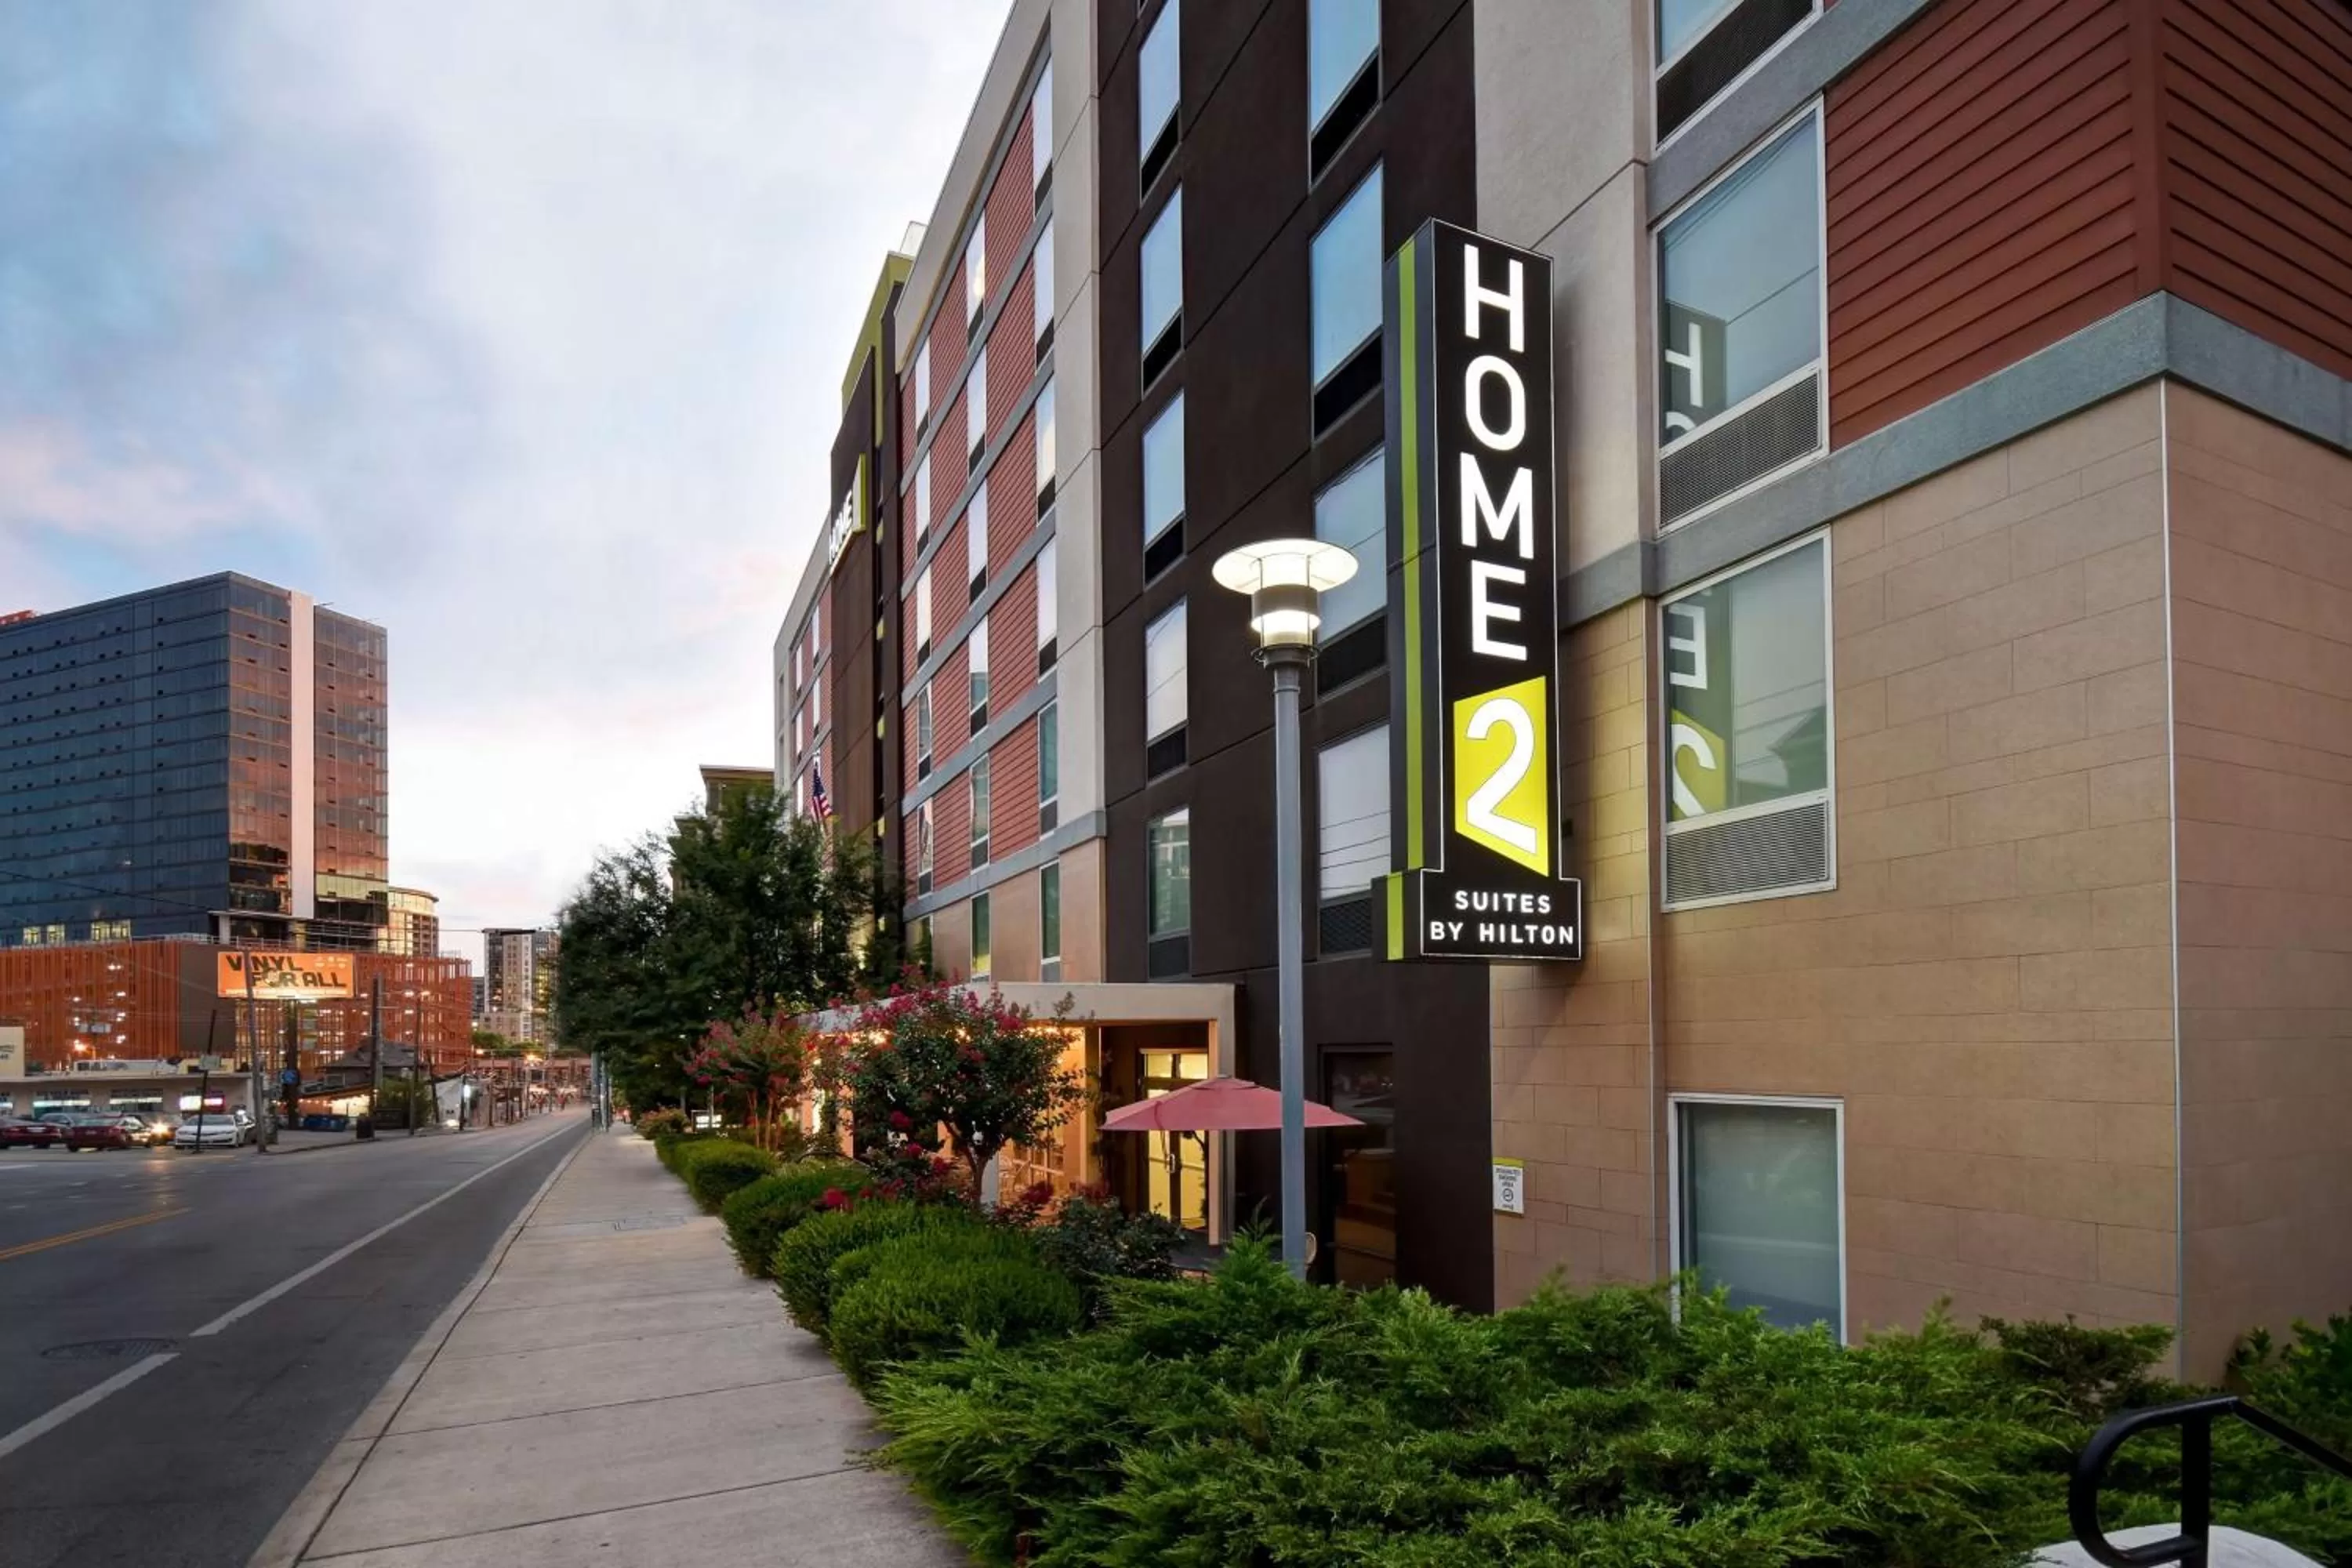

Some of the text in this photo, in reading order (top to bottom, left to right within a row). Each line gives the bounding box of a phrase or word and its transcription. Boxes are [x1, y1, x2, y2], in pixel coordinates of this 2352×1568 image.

[1461, 243, 1537, 855] HOME 2
[1454, 889, 1552, 914] SUITES
[1429, 920, 1574, 946] BY HILTON
[225, 954, 303, 971] VNYL
[302, 971, 347, 988] ALL
